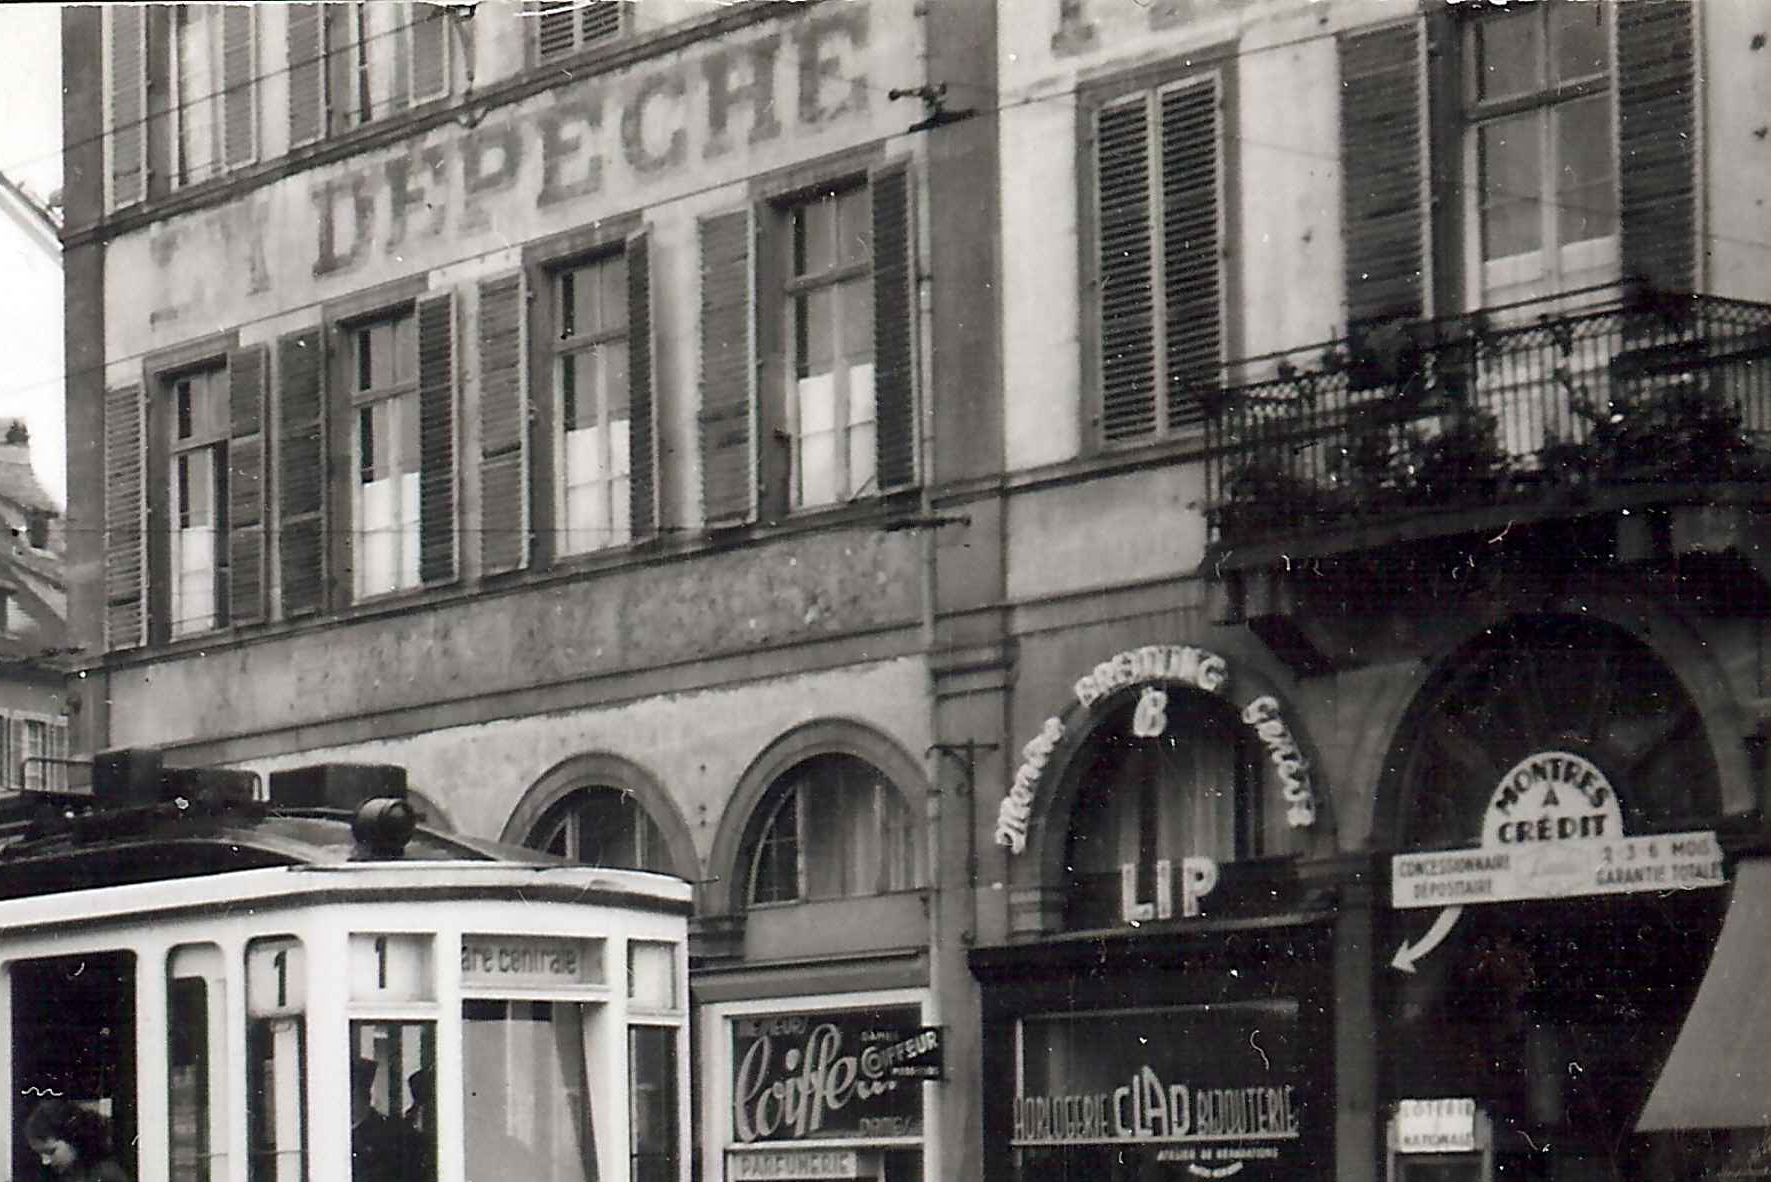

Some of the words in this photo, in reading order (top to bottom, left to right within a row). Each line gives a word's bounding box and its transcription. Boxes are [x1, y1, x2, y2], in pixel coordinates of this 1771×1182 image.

[1495, 757, 1611, 814] MONTRES
[1498, 813, 1609, 843] CRÉDIT
[1122, 857, 1217, 920] LIP
[273, 950, 287, 1007] 1
[375, 935, 387, 989] 1
[498, 946, 578, 975] centrale
[1113, 1065, 1190, 1138] CLAD
